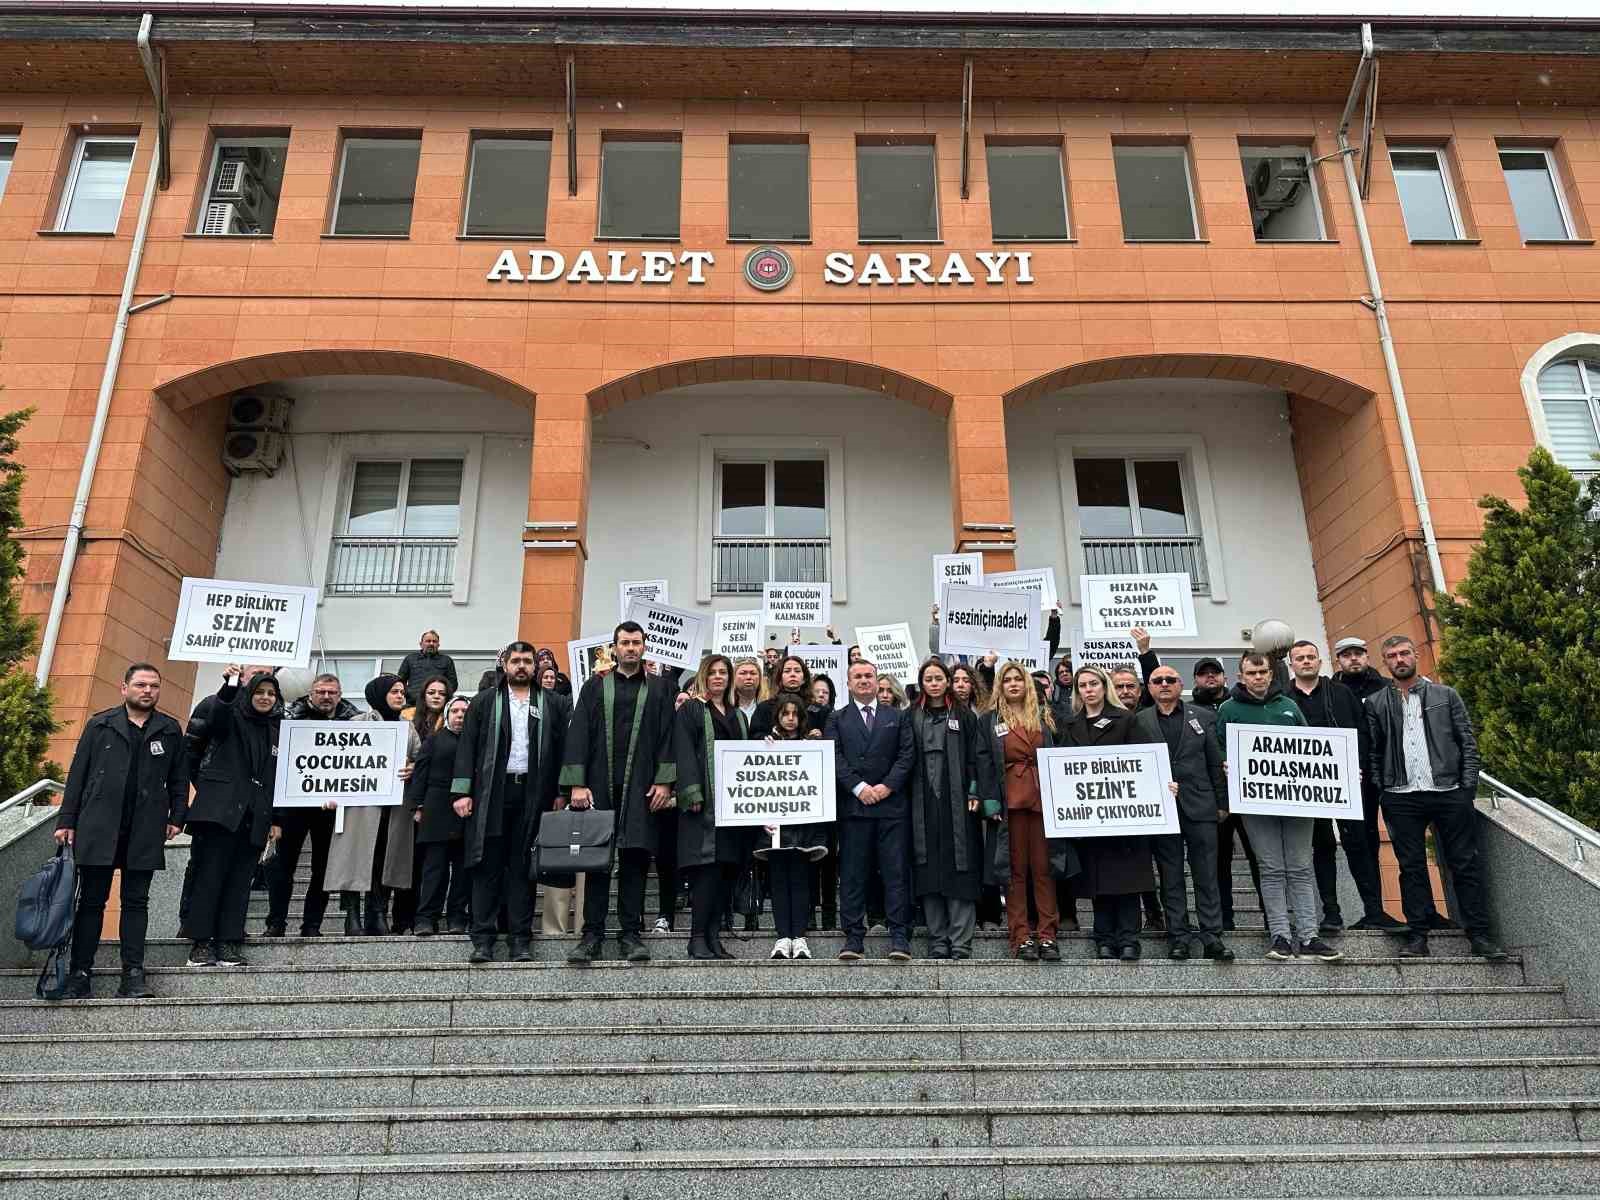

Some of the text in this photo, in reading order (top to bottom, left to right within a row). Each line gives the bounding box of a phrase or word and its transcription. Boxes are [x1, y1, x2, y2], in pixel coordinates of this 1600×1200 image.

[486, 249, 1035, 285] ADALET SARAYI
[945, 562, 971, 576] SEZİN
[770, 589, 821, 600] BİR ÇOCUĞUN
[1110, 582, 1158, 592] HIZINA
[206, 592, 288, 612] HEP BİRLİKTE
[770, 601, 820, 610] HAKKI YERDE
[1114, 592, 1156, 604] SAHİP
[648, 610, 684, 627] HIZINA
[775, 612, 815, 621] KALMASIN
[948, 608, 1027, 631] #seziniçinadalet
[1099, 606, 1175, 618] ÇIKSAYDIN
[212, 611, 276, 634] SEZİN'E
[647, 622, 680, 636] SAHİP
[1135, 619, 1172, 628] ZEKALI
[185, 632, 294, 653] SAHİP ÇIKIYORUZ
[644, 632, 688, 651] KSAYDIN
[721, 644, 754, 654] OLMAYA
[1084, 641, 1133, 649] SUSARSA
[804, 656, 838, 669] EZİN'İN
[1079, 650, 1138, 660] VİCDANLAR
[315, 732, 372, 750] BAŞKA
[1252, 736, 1333, 756] ARAMIZDA
[295, 755, 388, 774] ÇOCUKLAR
[743, 754, 802, 766] ADALET
[1064, 757, 1143, 775] HEP BİRLİKTE
[735, 770, 809, 781] SUSARSA
[1248, 758, 1339, 783] DOLAŞMANI
[301, 774, 378, 792] ÖLMESİN
[1075, 777, 1136, 800] SEZİN'E
[1242, 777, 1347, 804] İSTEMİYORUZ.
[727, 784, 818, 798] VİCDANLAR
[734, 801, 811, 816] KONUŞUR
[1057, 803, 1162, 824] SAHİP ÇIKIYORUZ
